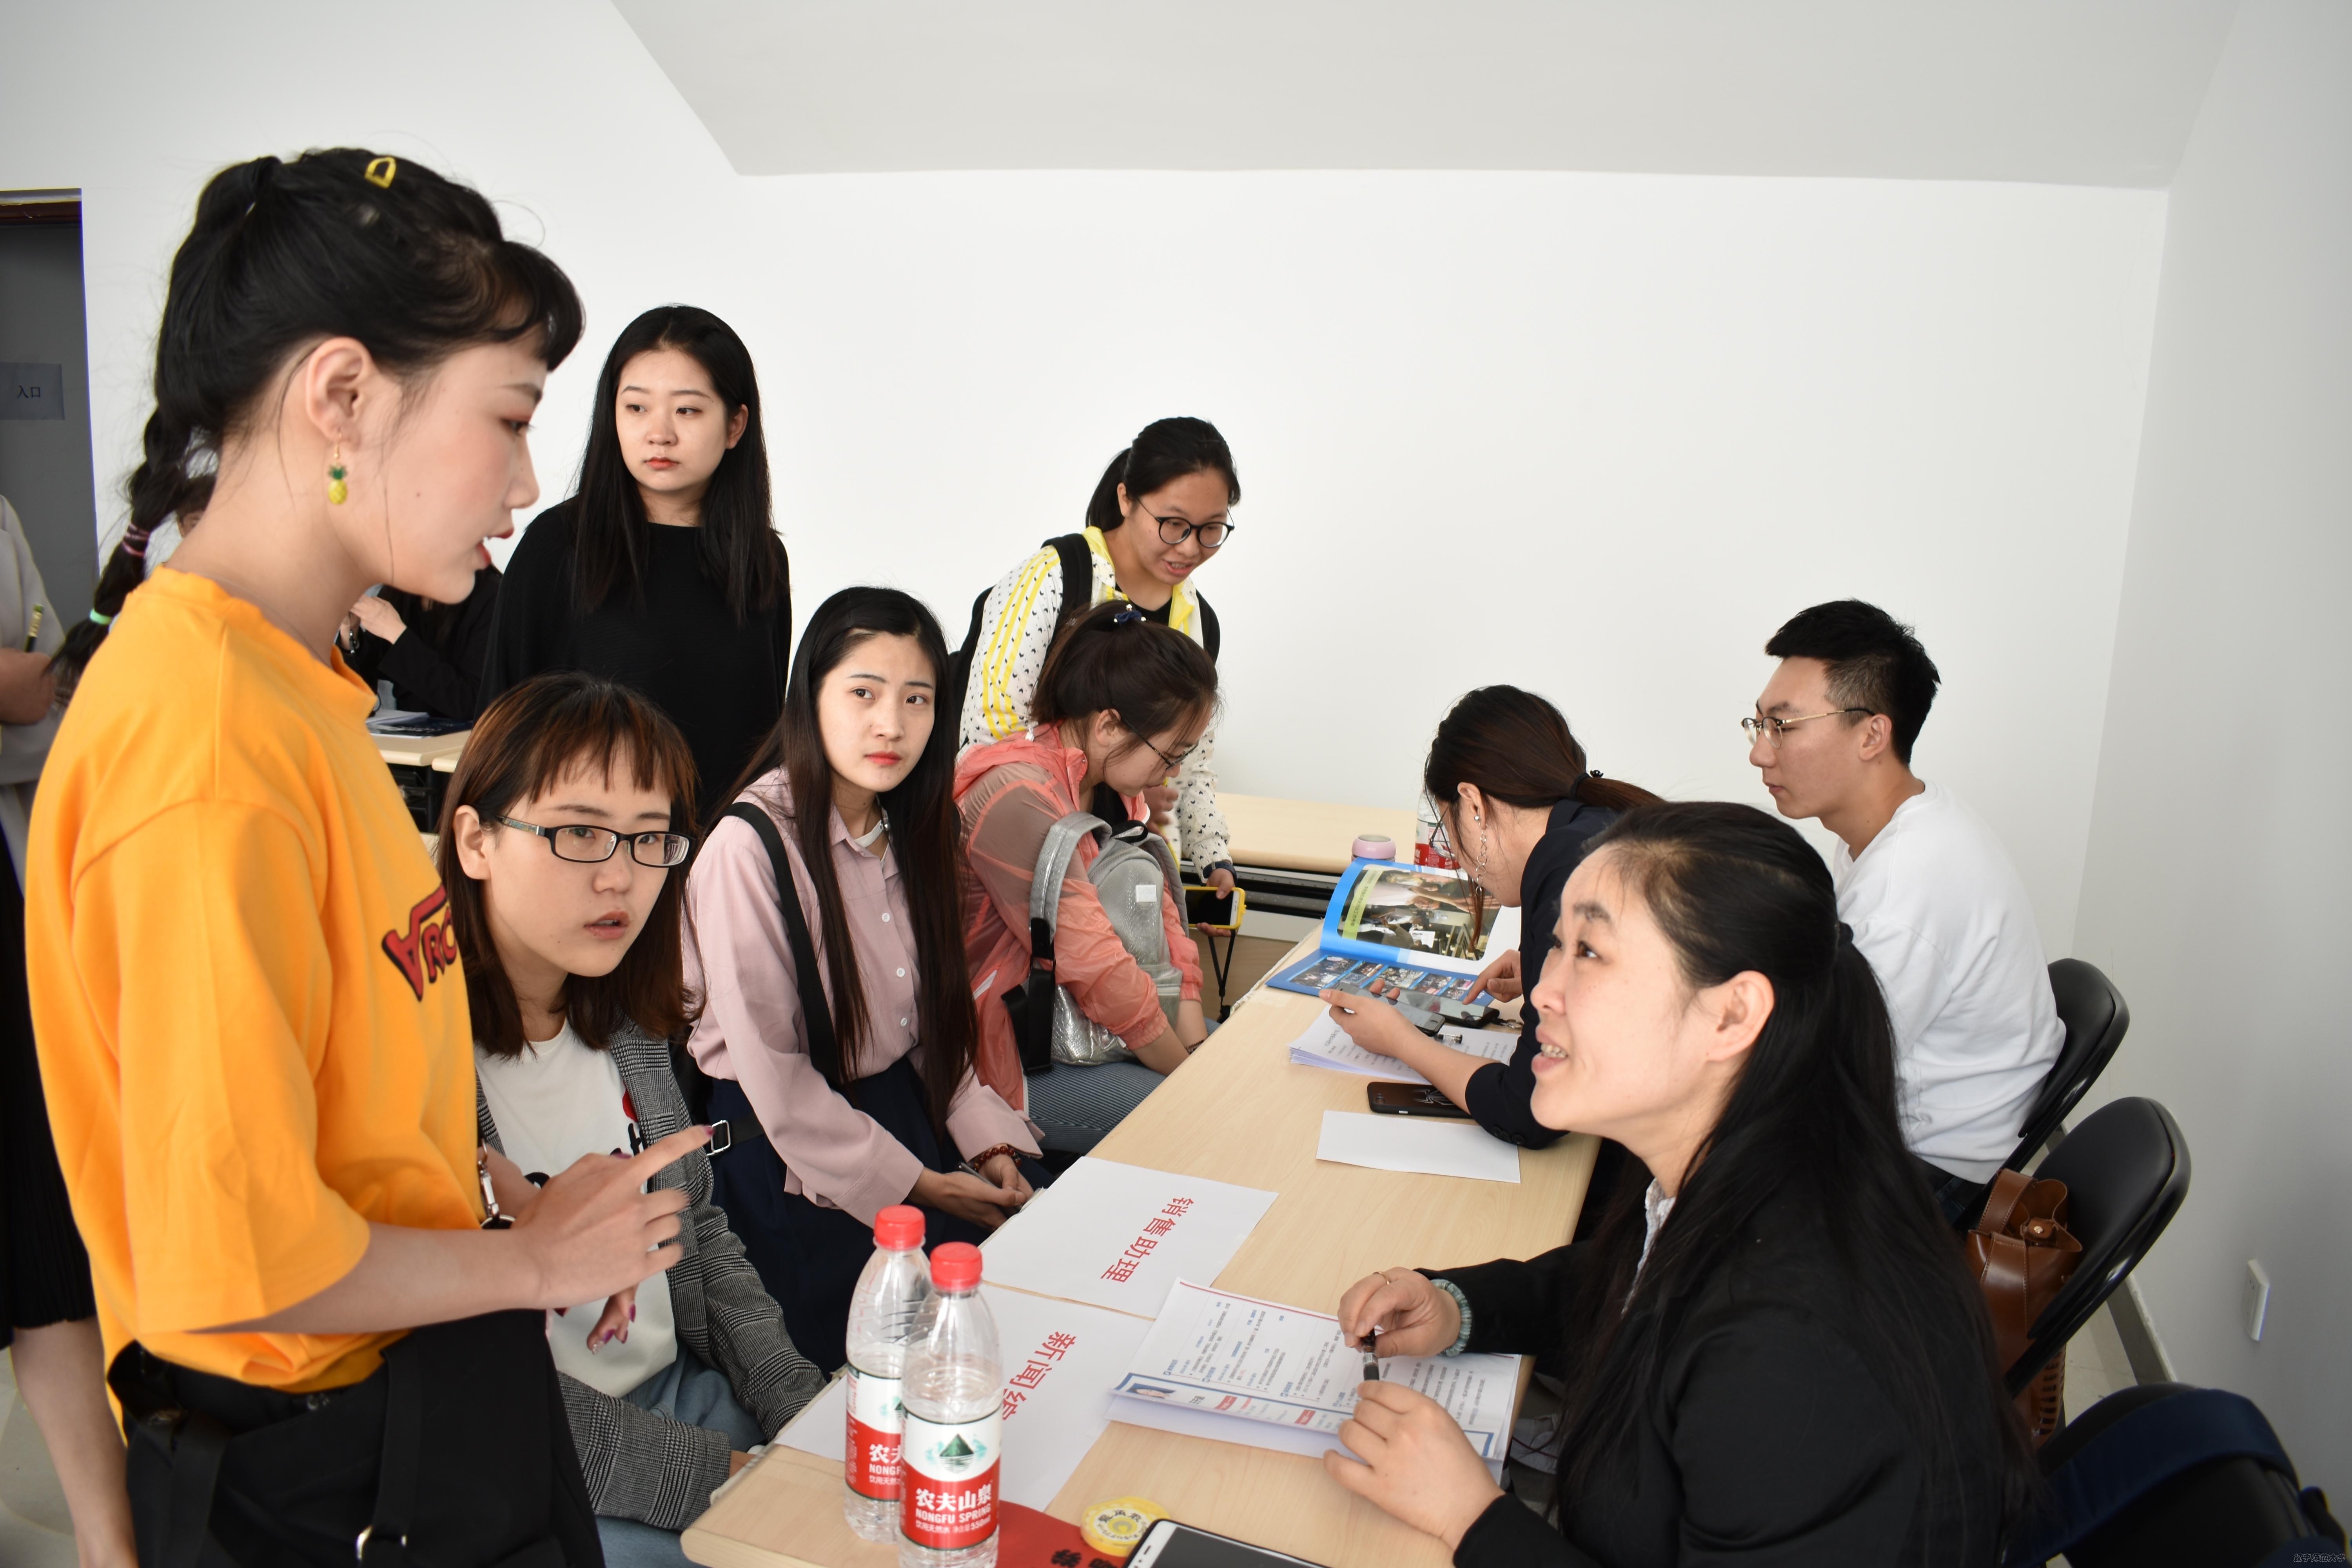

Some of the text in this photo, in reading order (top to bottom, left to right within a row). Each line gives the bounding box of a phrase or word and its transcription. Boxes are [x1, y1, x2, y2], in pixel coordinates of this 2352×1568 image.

[16, 385, 41, 399] 入口
[1100, 1198, 1194, 1283] 销售助理
[915, 1484, 992, 1512] 农夫山泉
[915, 1503, 992, 1524] NONGFU SPRING
